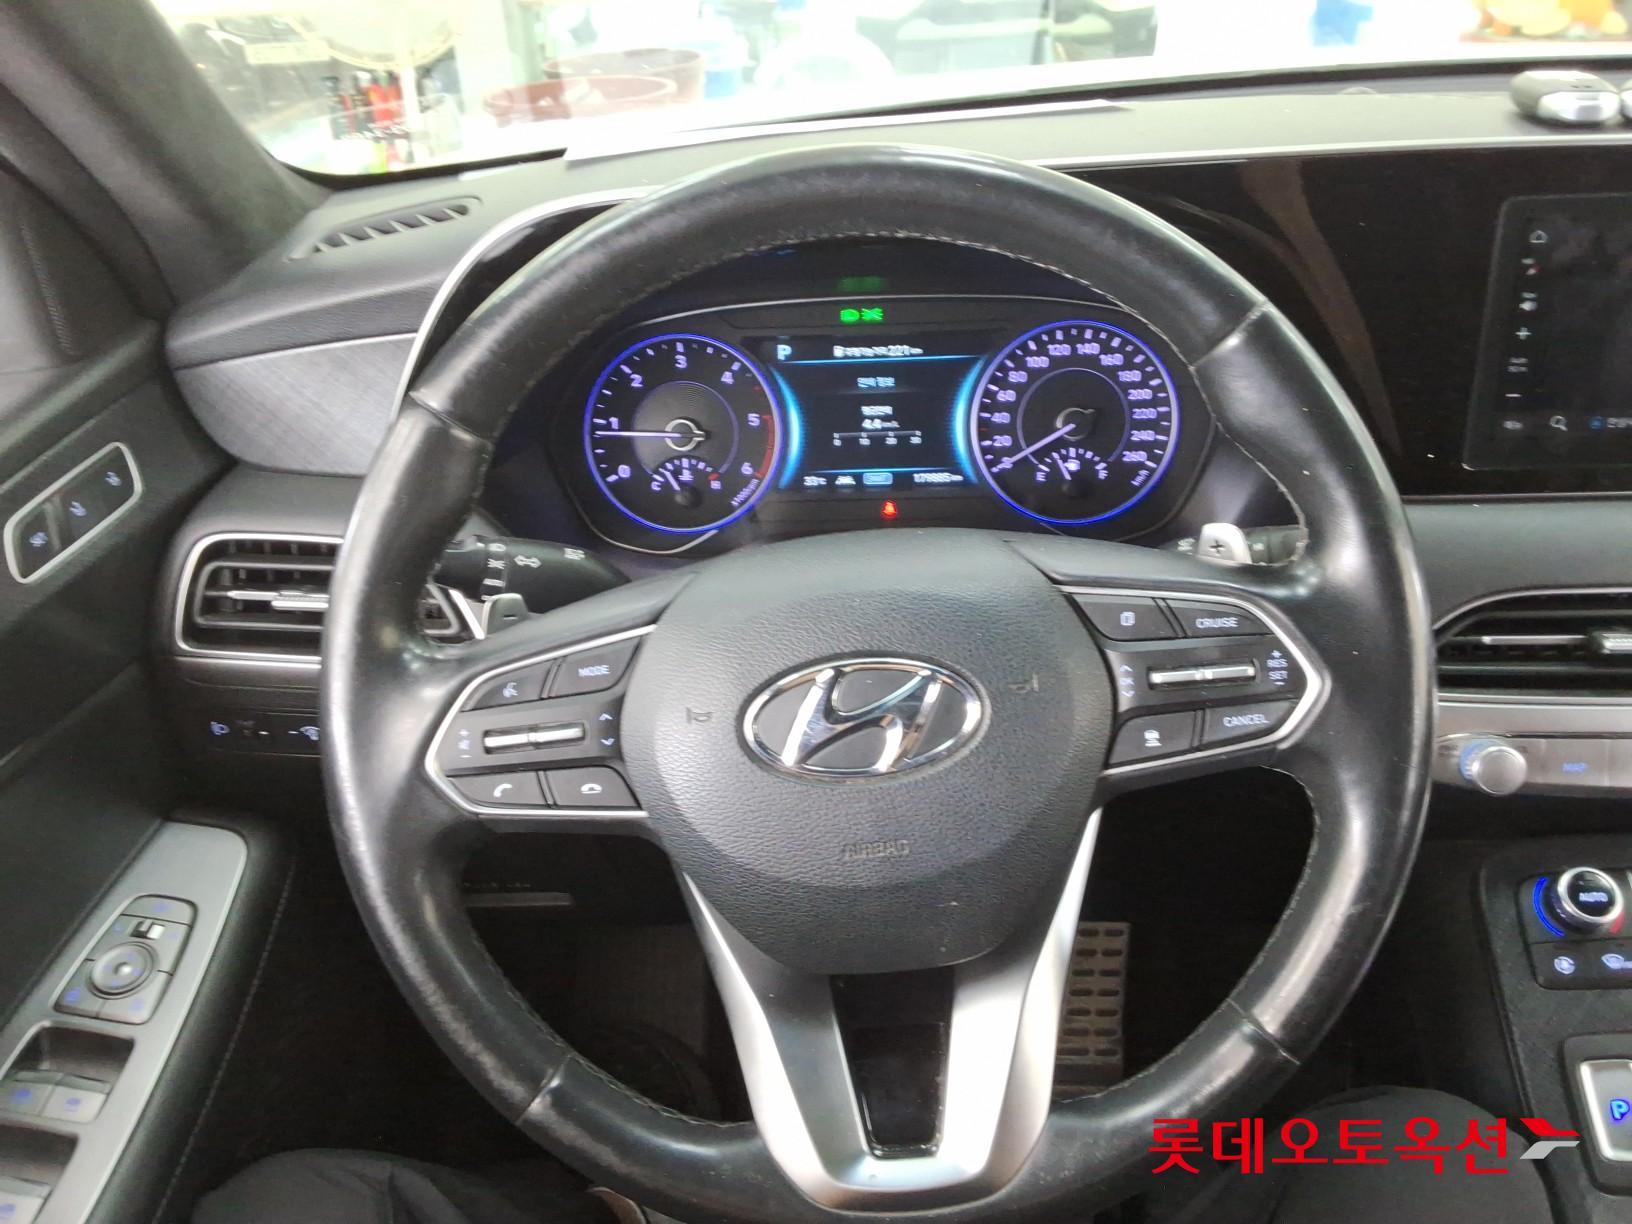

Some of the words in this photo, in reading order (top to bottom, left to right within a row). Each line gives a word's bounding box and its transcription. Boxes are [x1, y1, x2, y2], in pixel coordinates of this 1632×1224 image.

[776, 344, 793, 361] P
[1047, 344, 1072, 356] 120
[1076, 343, 1101, 355] 140
[674, 354, 688, 369] 3
[1025, 356, 1050, 368] 100
[1099, 353, 1124, 366] 160
[630, 373, 644, 388] 2
[720, 371, 735, 385] 4
[1008, 371, 1028, 383] 80
[1118, 370, 1142, 382] 180
[997, 389, 1017, 402] 60
[1127, 389, 1153, 401] 200
[747, 413, 761, 427] 5
[991, 412, 1012, 424] 40
[1132, 408, 1158, 420] 220
[608, 416, 620, 430] 1
[992, 434, 1013, 448] 20
[1130, 430, 1157, 441] 240
[1122, 451, 1148, 463] 260
[618, 464, 632, 479] 0
[741, 461, 754, 476] 6
[1098, 469, 1109, 480] F
[1035, 471, 1047, 482] E
[1195, 617, 1239, 629] CRUISE
[1266, 658, 1288, 669] RES
[1268, 671, 1288, 681] SET
[1223, 714, 1270, 728] CANCEL
[841, 839, 911, 860] AIRBAG
[1610, 1099, 1630, 1121] P
